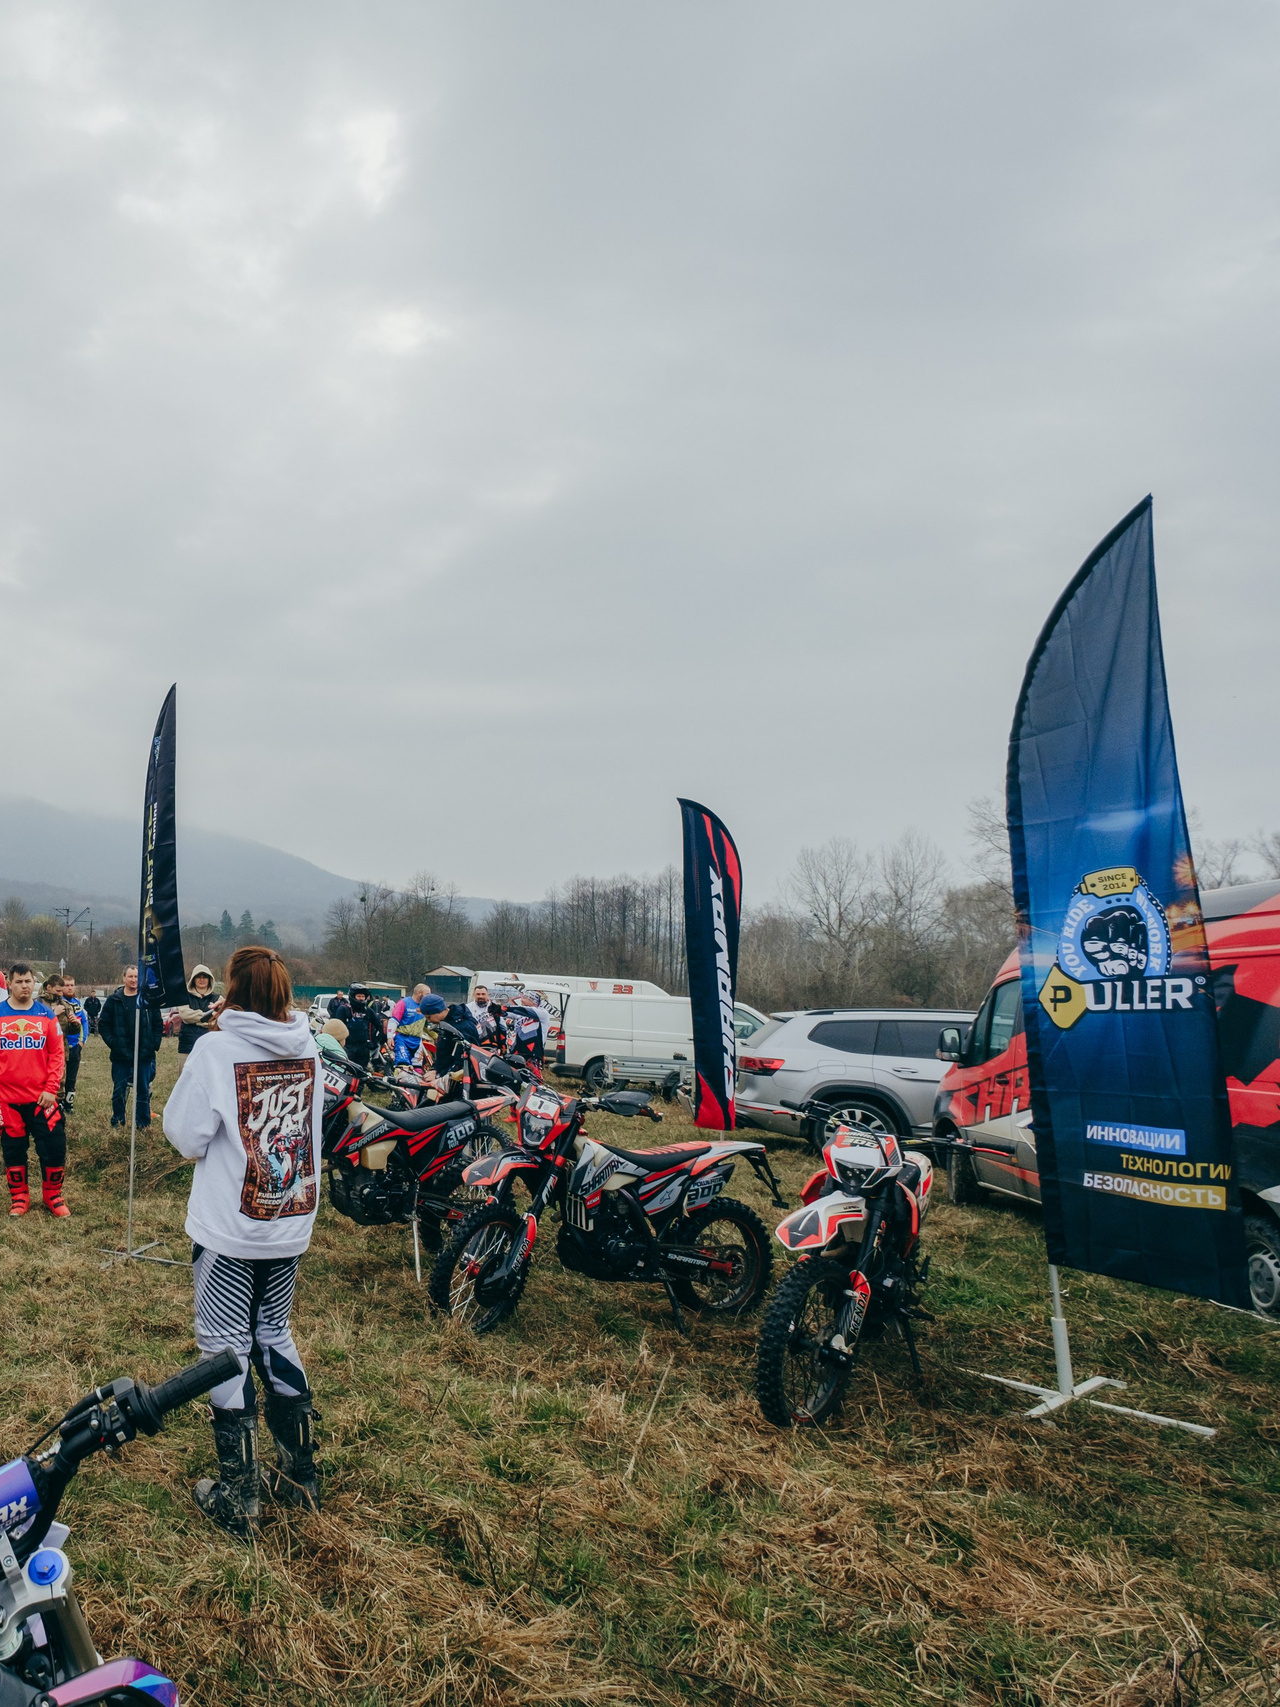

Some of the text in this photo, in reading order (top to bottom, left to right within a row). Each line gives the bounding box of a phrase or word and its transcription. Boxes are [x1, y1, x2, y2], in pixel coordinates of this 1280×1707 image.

[1097, 873, 1127, 883] SINCE
[1103, 882, 1127, 891] 2014
[1063, 898, 1096, 938] RIDE
[1061, 943, 1087, 978] YOU
[612, 984, 634, 995] 33
[709, 865, 735, 1101] SHARMAX
[0, 1035, 23, 1050] Red
[323, 1073, 339, 1087] 111
[247, 1078, 313, 1131] JUST
[348, 1122, 390, 1152] SHARMAX
[446, 1121, 475, 1144] 300
[1086, 1124, 1180, 1150] ИННОВАЦИИ
[578, 1157, 623, 1196] SHARMAX
[1120, 1153, 1232, 1180] ТЕХНОЛОГИИ
[1083, 1172, 1222, 1205] БЕЗОПАСНОСТЬ
[511, 1238, 531, 1272] KENDA
[667, 1253, 709, 1267] SHARMAX
[850, 1291, 869, 1337] KENDA
